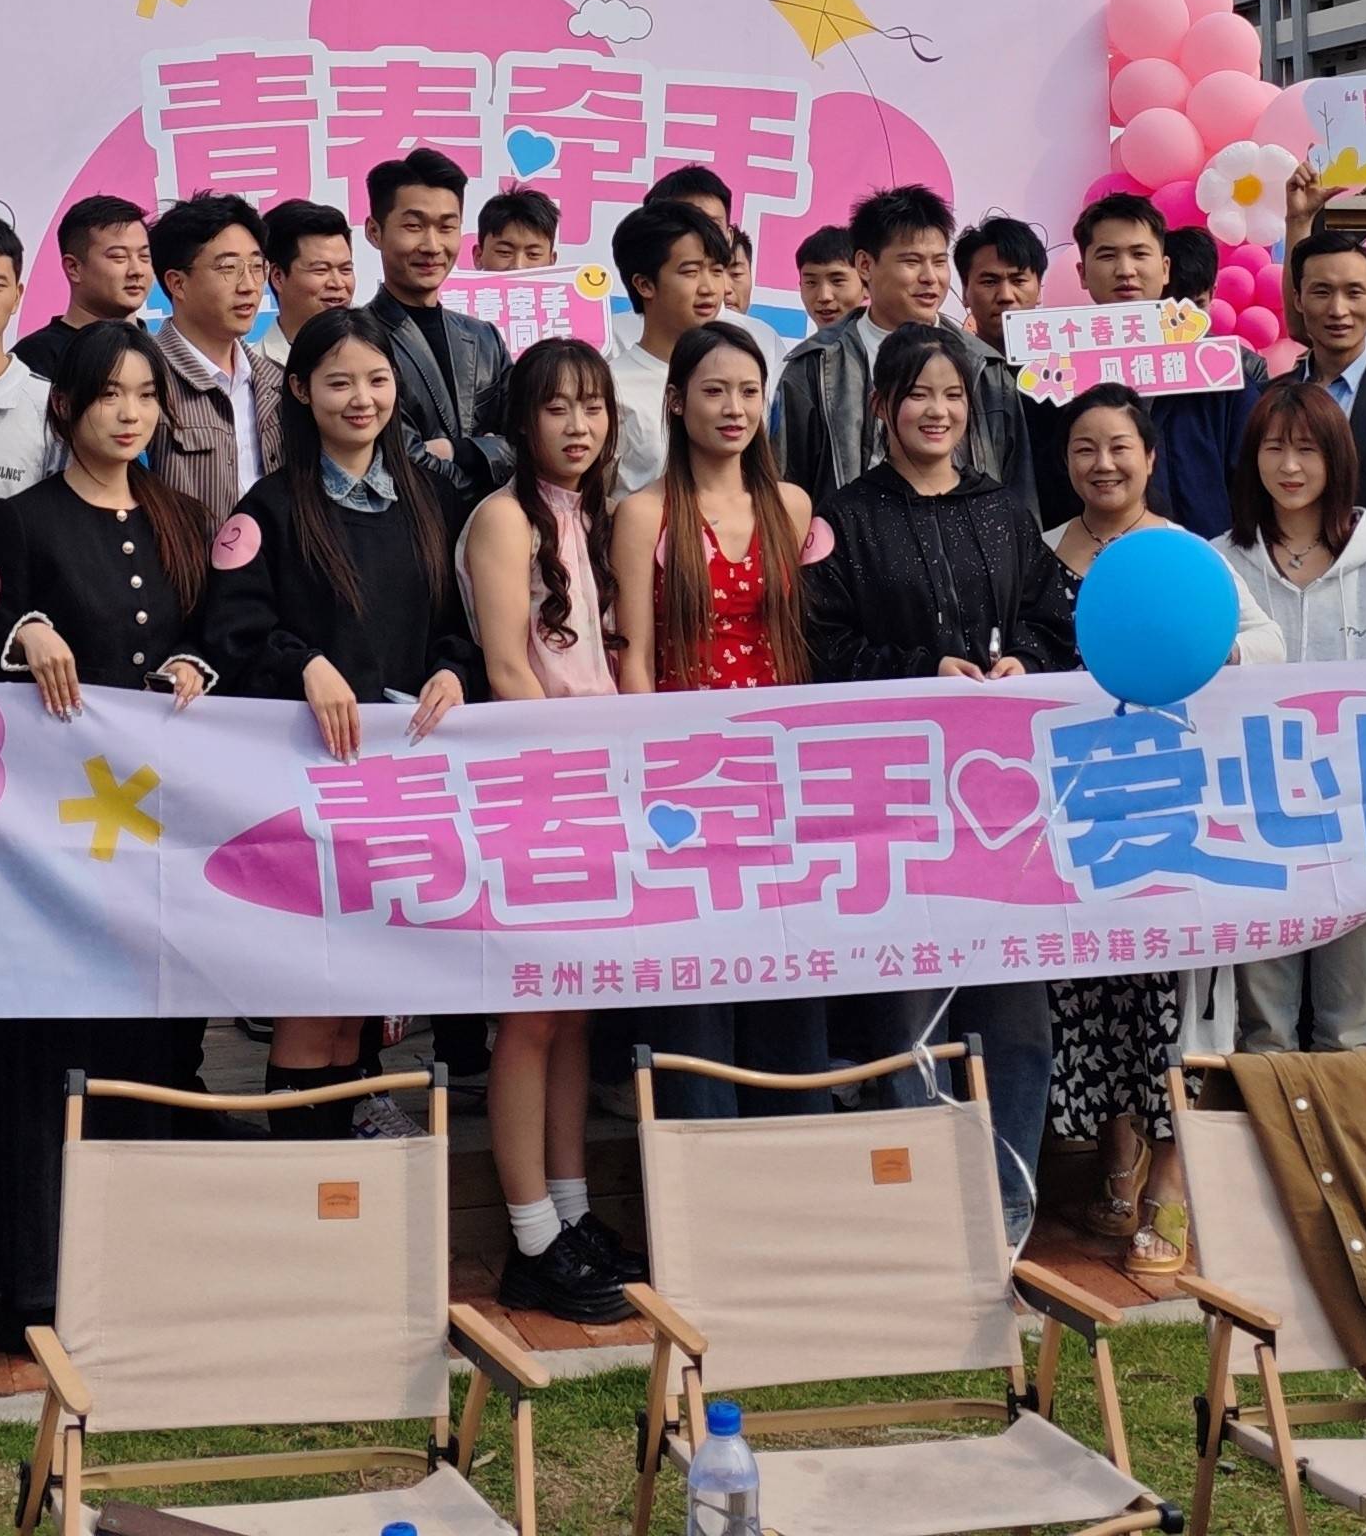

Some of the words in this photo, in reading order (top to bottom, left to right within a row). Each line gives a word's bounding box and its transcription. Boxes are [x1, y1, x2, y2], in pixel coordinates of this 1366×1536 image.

[158, 51, 797, 246] 青春牵手
[1025, 314, 1147, 352] 这个春天
[1099, 351, 1188, 385] 风很甜
[221, 526, 242, 552] 2
[305, 732, 937, 917] 青春牵手
